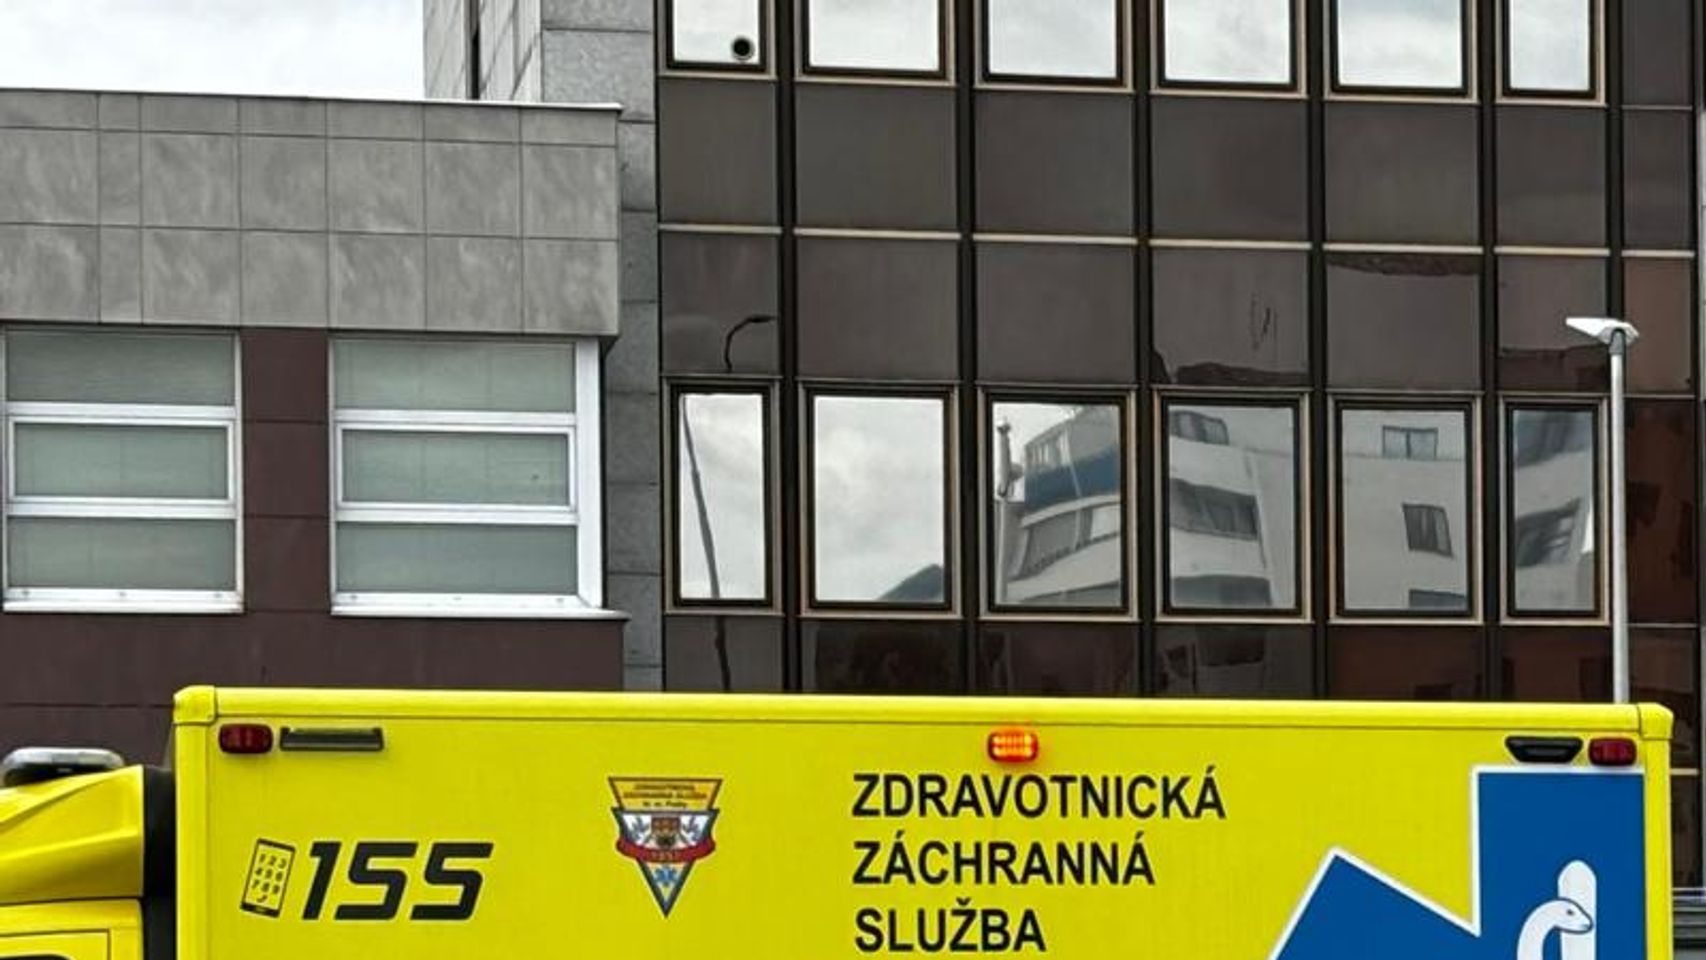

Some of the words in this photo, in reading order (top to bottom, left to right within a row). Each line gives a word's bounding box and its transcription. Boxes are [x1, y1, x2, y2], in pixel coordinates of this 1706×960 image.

[851, 764, 1226, 819] ZDRAVOTNICKÁ
[301, 841, 494, 921] 155
[852, 830, 1155, 885] ZÁCHRANNÁ
[855, 897, 1047, 953] SLUŽBA
